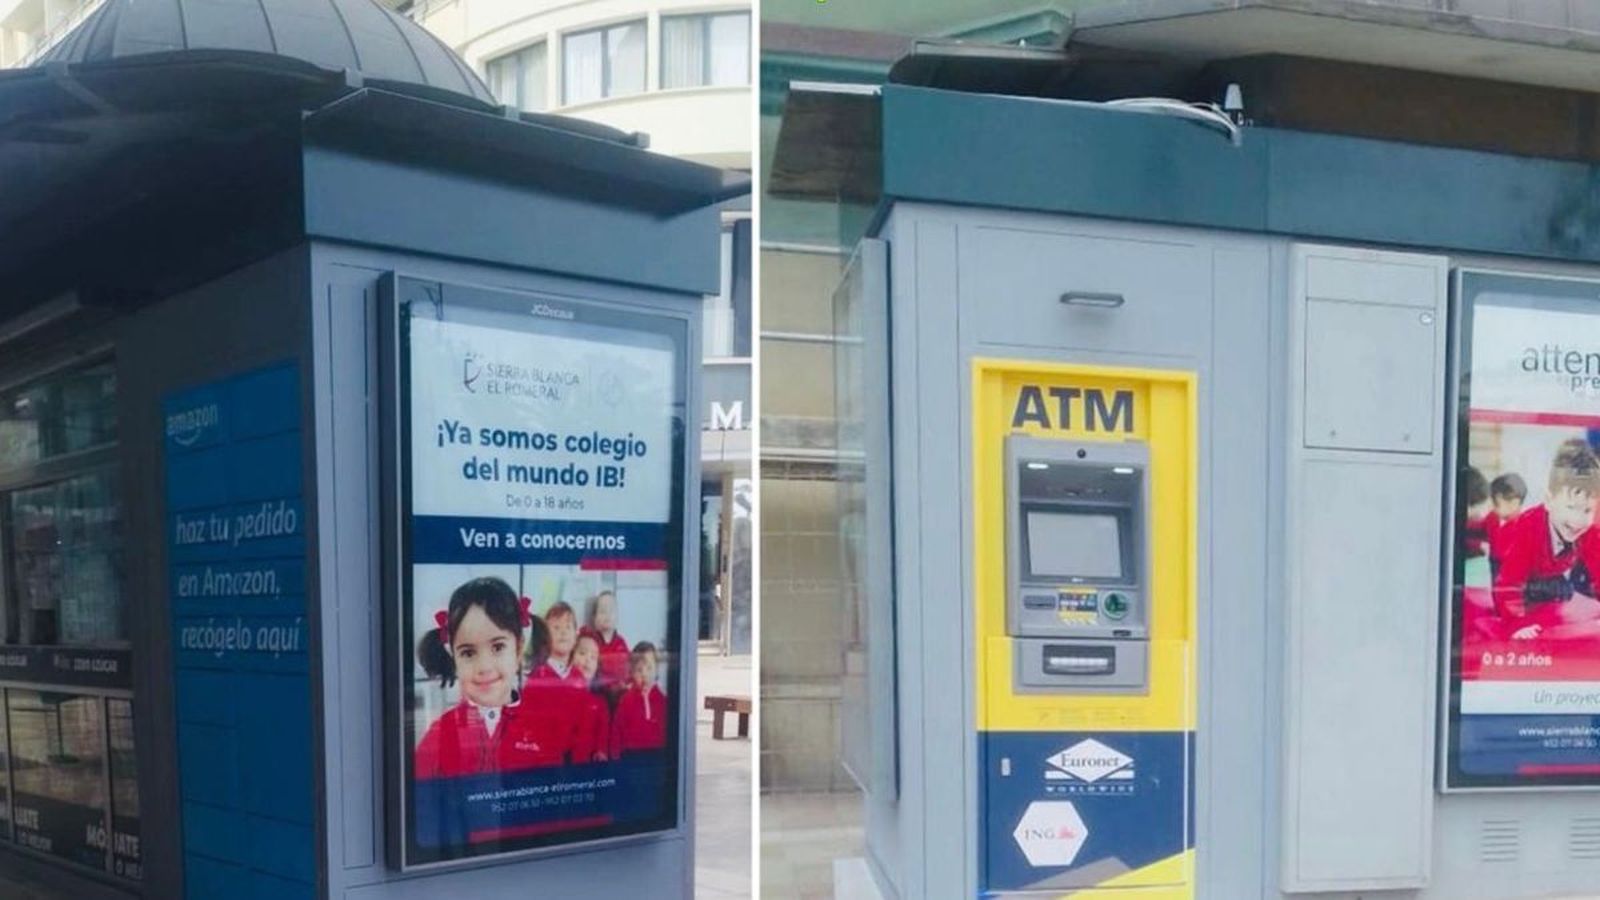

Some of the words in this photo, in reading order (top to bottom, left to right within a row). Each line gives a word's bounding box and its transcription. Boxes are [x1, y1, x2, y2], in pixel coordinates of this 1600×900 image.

[486, 363, 528, 381] SIERRA
[533, 369, 580, 386] BLANCA
[486, 381, 500, 395] EL
[505, 384, 560, 400] ROMERAL
[167, 404, 218, 436] amazon
[1011, 385, 1135, 433] ATM
[437, 419, 472, 448] ¡Ya
[479, 426, 558, 451] somos
[564, 432, 648, 462] colegio
[462, 457, 500, 482] del
[506, 463, 590, 487] mundo
[596, 465, 626, 488] IB!
[506, 494, 523, 508] De
[535, 499, 543, 510] a
[544, 496, 555, 510] 18
[557, 496, 585, 511] años
[176, 514, 206, 545] haz
[210, 513, 229, 541] tu
[233, 500, 297, 547] pedido
[460, 528, 500, 549] Ven
[505, 531, 517, 549] a
[521, 531, 626, 551] conocernos
[178, 574, 199, 598] en
[181, 617, 252, 658] recógelo
[257, 616, 301, 659] aquí
[1482, 652, 1493, 666] 0
[1494, 653, 1504, 666] a
[1507, 652, 1516, 666] 2
[1518, 652, 1553, 667] años
[1533, 690, 1553, 704] Un
[1060, 753, 1119, 769] Euronet
[1045, 785, 1135, 794] WORLDWIDE
[1024, 829, 1055, 839] ING
